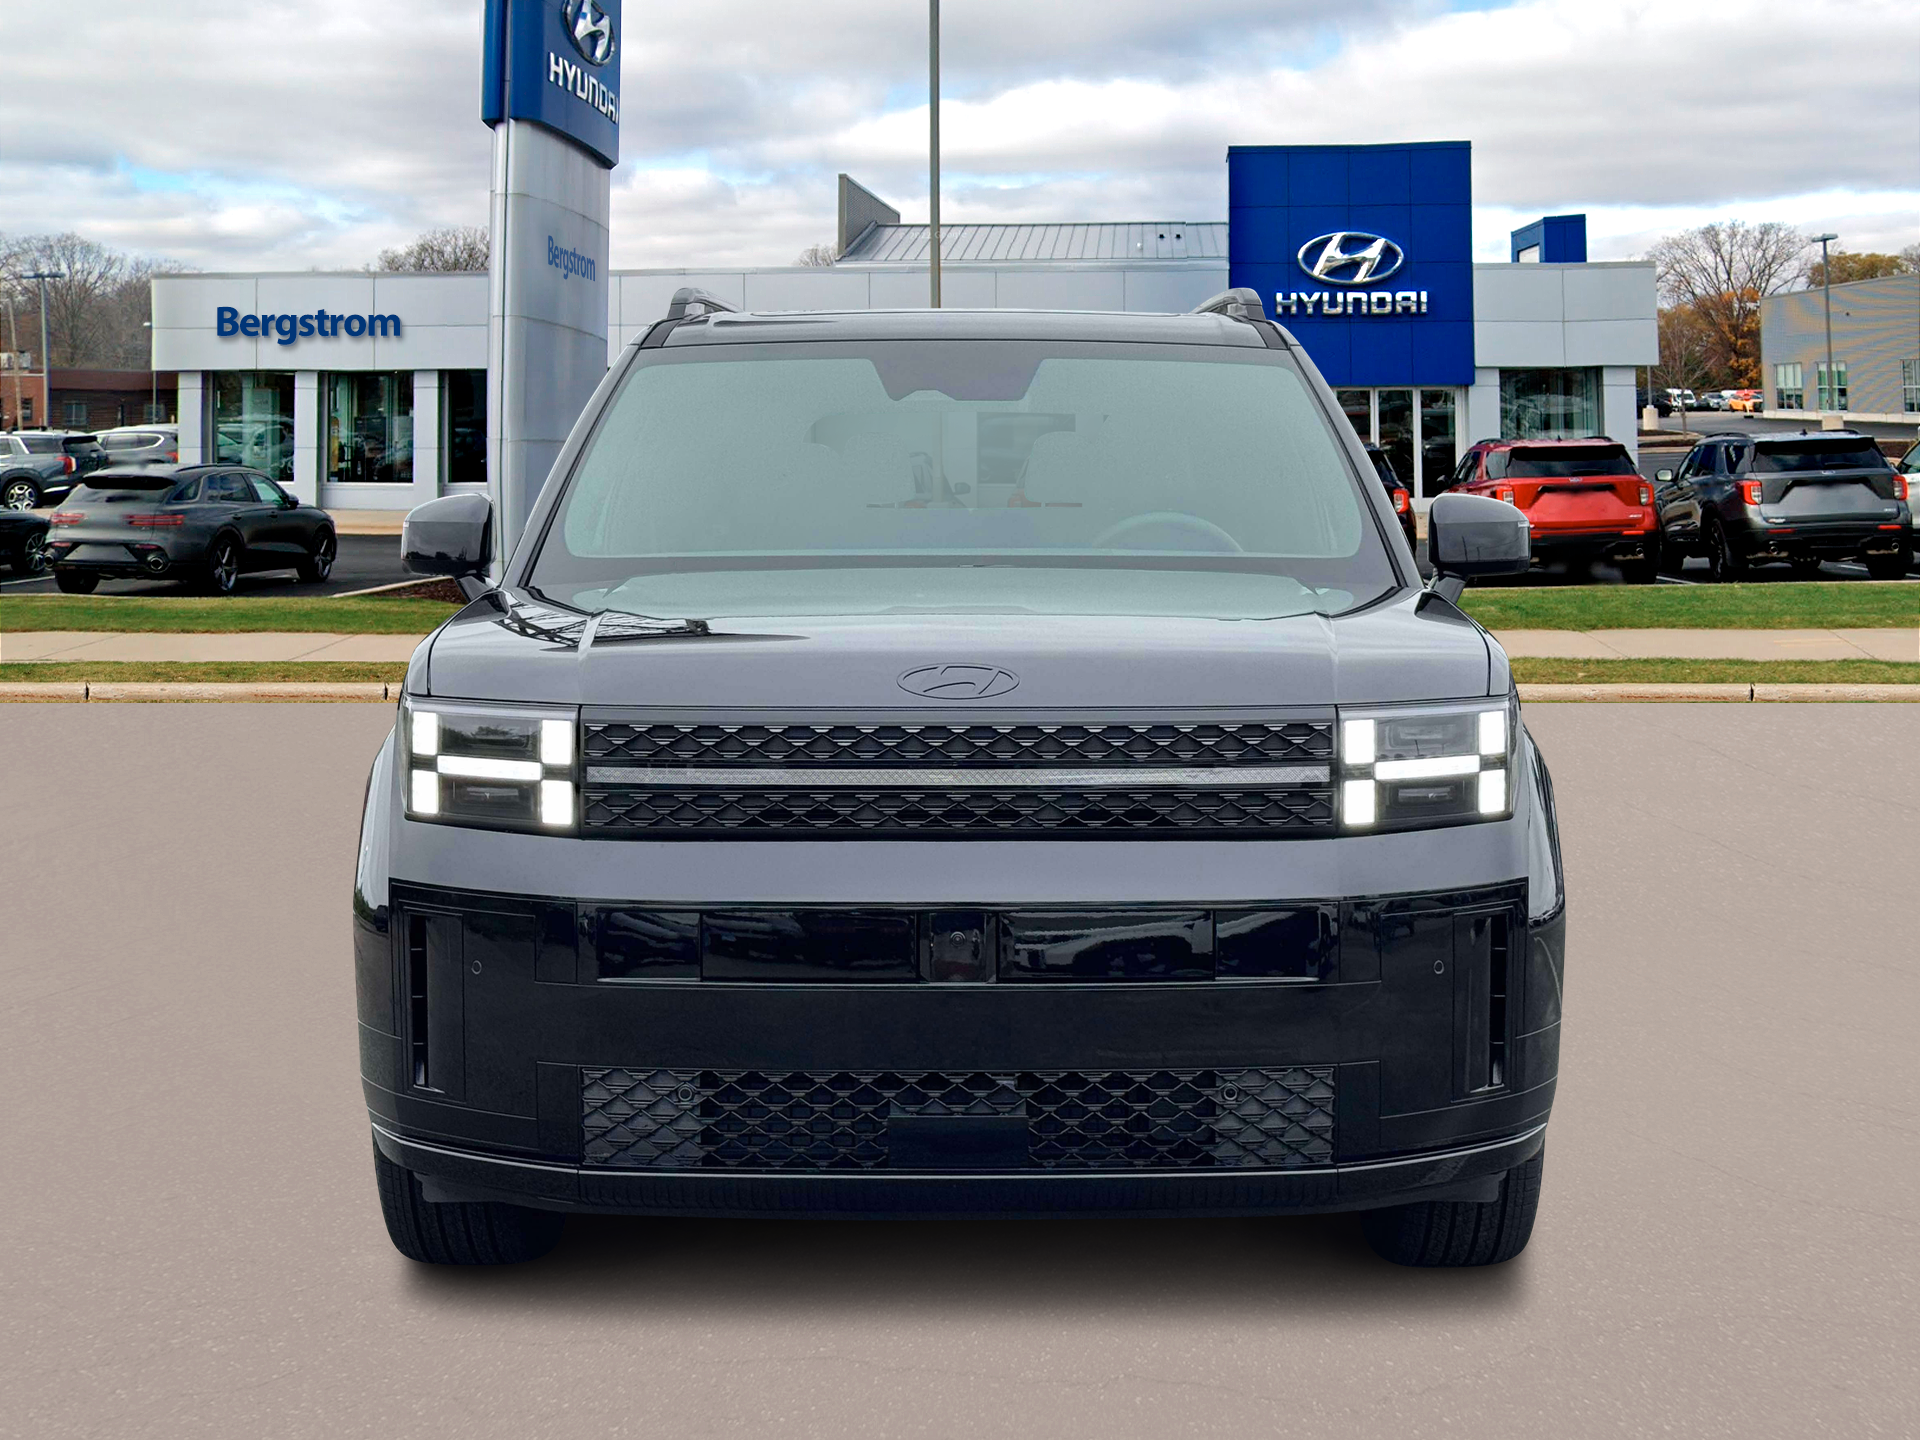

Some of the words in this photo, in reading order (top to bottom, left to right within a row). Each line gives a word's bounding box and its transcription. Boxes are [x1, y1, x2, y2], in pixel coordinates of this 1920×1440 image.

[549, 51, 619, 124] HYUNDAI
[548, 235, 596, 282] Bergstrom
[1275, 290, 1428, 315] HYUNDAI
[216, 306, 401, 346] Bergstrom
